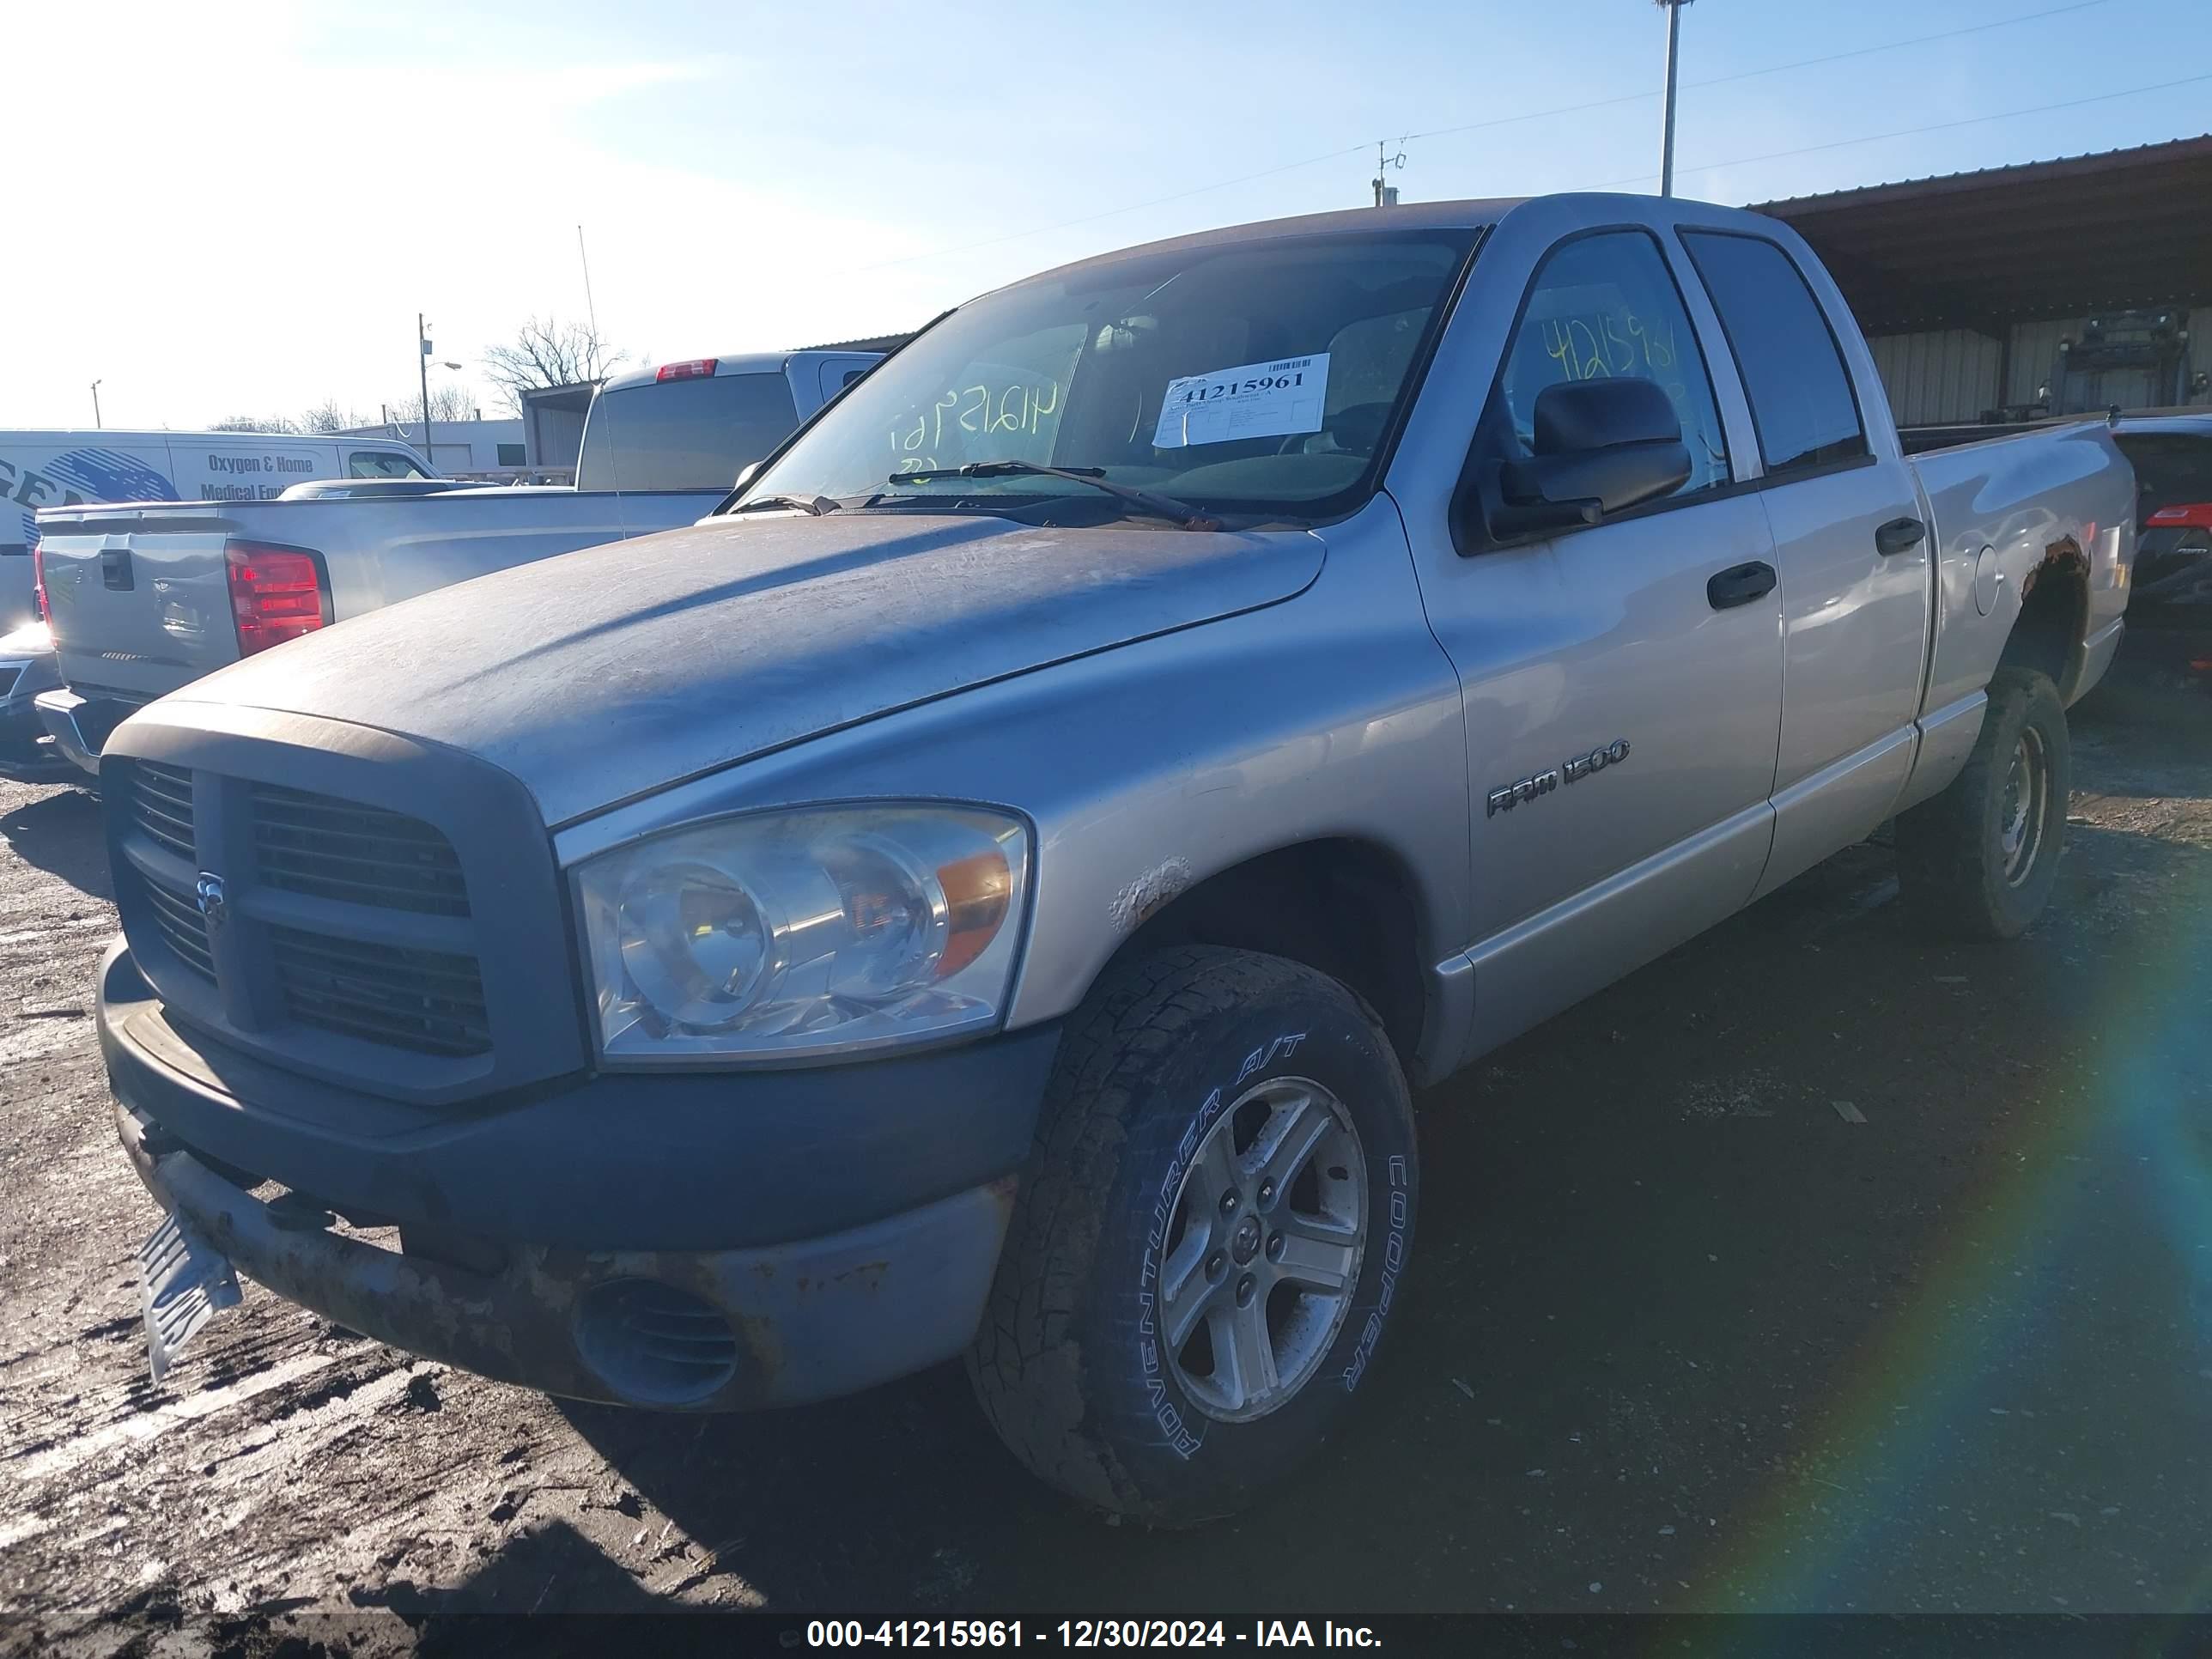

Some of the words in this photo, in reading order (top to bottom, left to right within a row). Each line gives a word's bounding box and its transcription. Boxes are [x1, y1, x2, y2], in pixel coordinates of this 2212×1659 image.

[1180, 372, 1304, 403] 41215961
[208, 454, 260, 474] Oxygen
[263, 456, 273, 471] &
[276, 456, 313, 473] Home
[201, 483, 254, 501] Medical
[1562, 738, 1631, 785] 1500
[1139, 1088, 1222, 1461] ADVENTURER
[1236, 1032, 1306, 1085] A/T
[1341, 1154, 1407, 1392] COOPER
